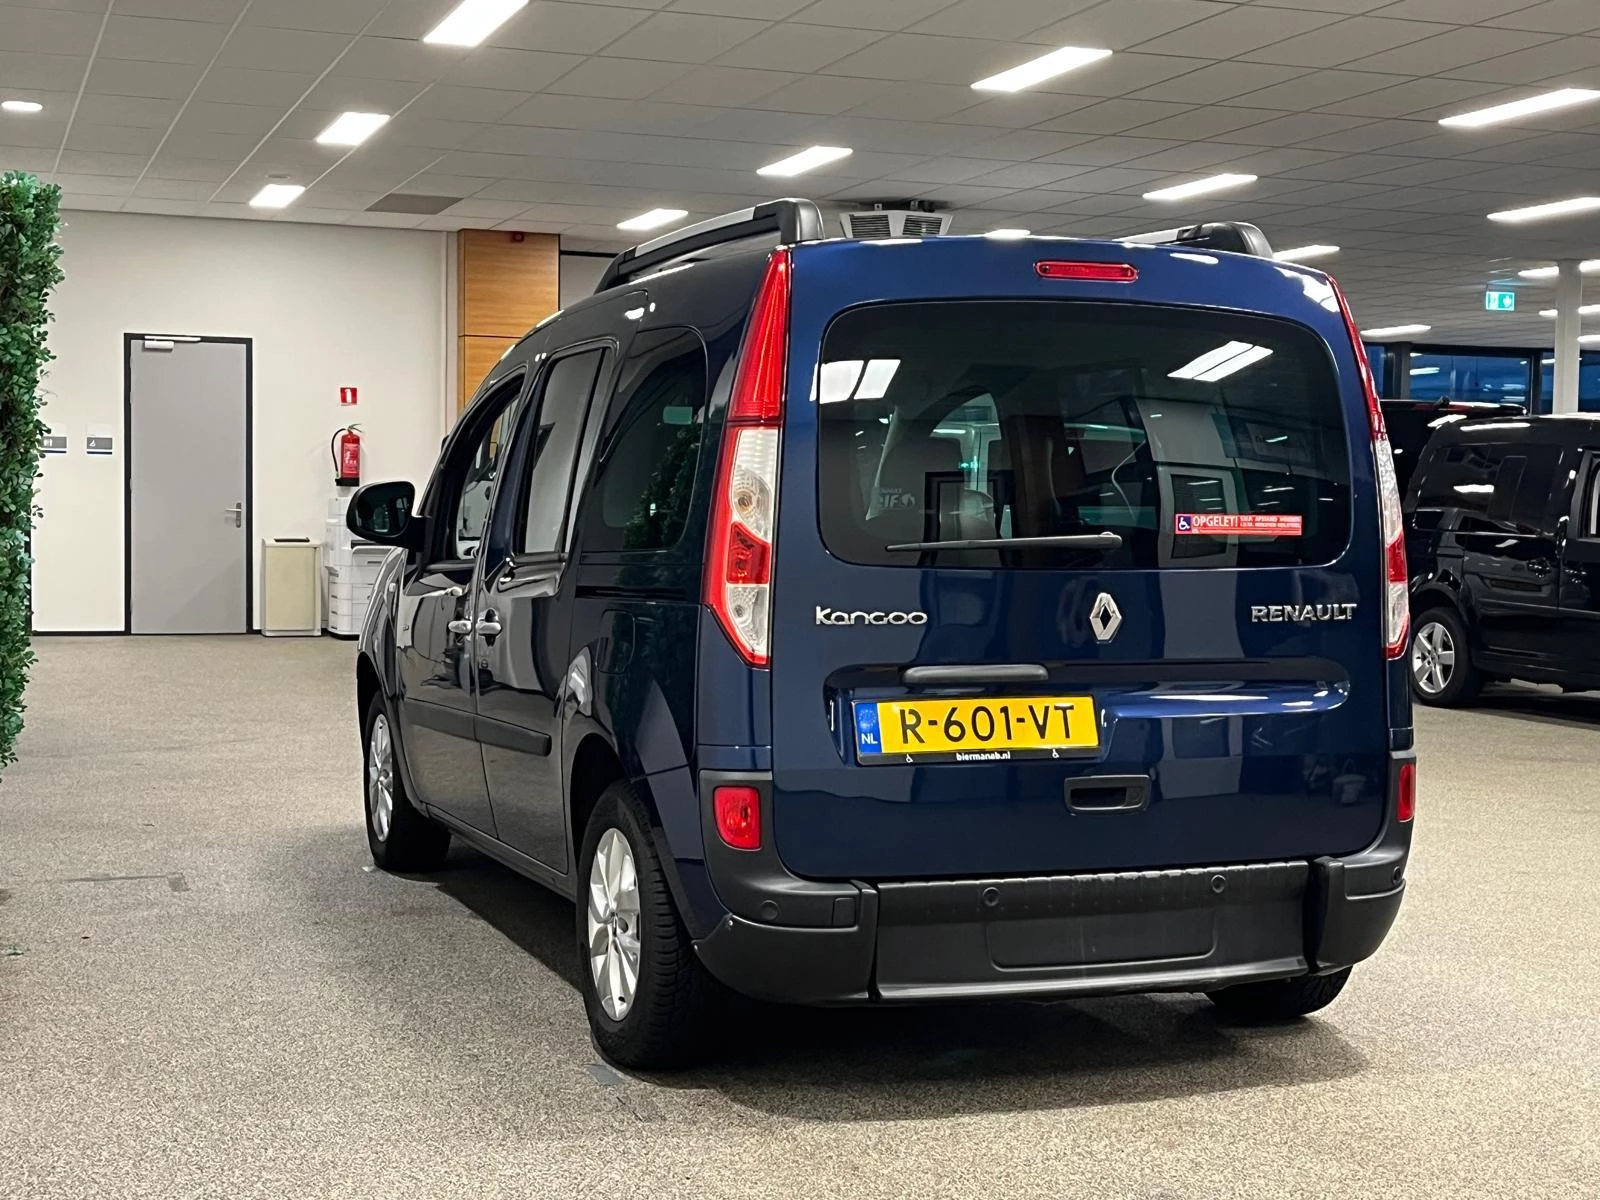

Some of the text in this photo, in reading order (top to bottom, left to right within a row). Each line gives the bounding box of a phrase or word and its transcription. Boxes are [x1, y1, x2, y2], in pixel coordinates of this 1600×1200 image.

[815, 605, 928, 626] Kangoo
[1251, 603, 1358, 623] RENAULT
[899, 703, 1075, 745] R-601-VT
[861, 733, 878, 744] NL
[956, 751, 1011, 761] biermanab.nl
